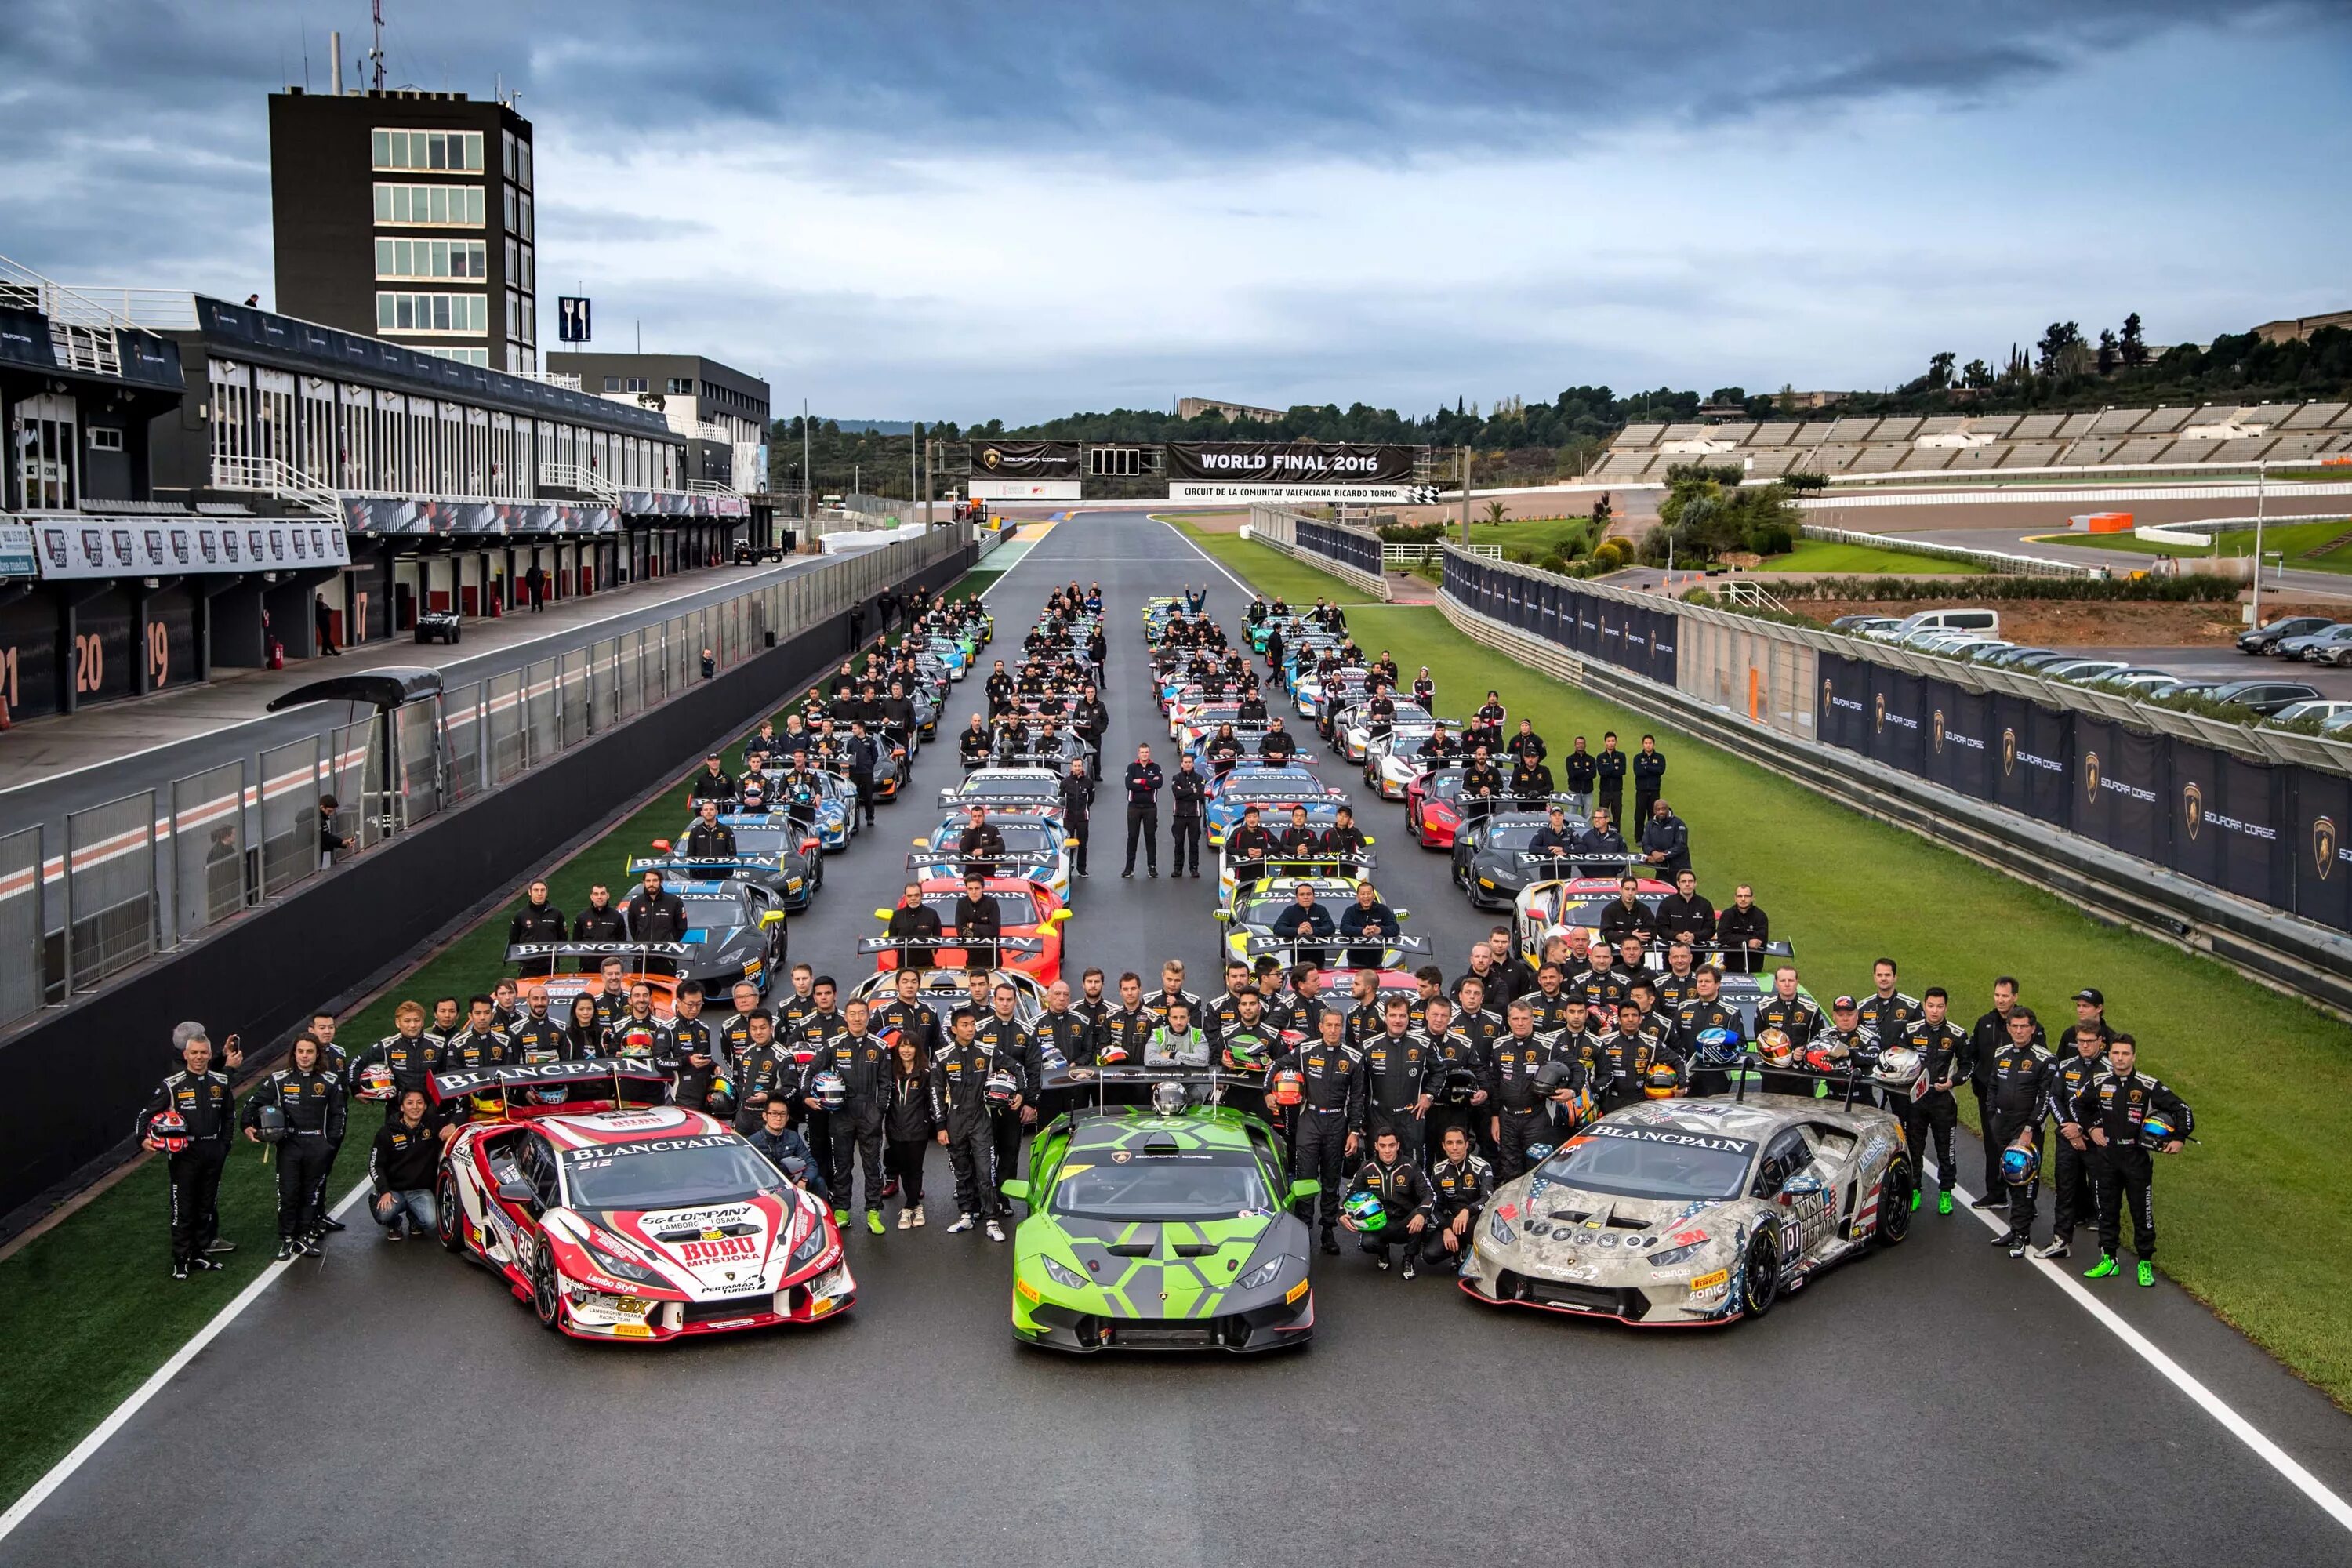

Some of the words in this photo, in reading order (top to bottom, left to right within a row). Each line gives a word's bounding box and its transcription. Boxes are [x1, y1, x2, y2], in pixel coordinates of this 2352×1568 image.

[1201, 454, 1266, 470] WORLD
[1272, 455, 1327, 470] FINAL
[1334, 456, 1378, 470] 2016
[1184, 488, 1214, 496] CIRCUIT
[1216, 488, 1225, 496] DE
[1229, 488, 1237, 496] LA
[1240, 488, 1283, 497] COMUNITAT
[1286, 488, 1331, 497] VALENCIANA
[1334, 489, 1367, 498] RICARDO
[357, 592, 367, 641] 17
[77, 633, 103, 692] 20
[147, 622, 168, 688] 19
[2042, 758, 2063, 771] CORSE
[943, 795, 1062, 804] BLANCPAIN
[1229, 793, 1346, 802] BLANCPAIN
[2132, 787, 2155, 802] CORSE
[2244, 822, 2276, 840] CORSE
[637, 857, 775, 867] BLANCPAIN
[913, 854, 1051, 864] BLANCPAIN
[517, 943, 691, 956] BLANCPAIN
[865, 937, 1035, 947] BLANCPAIN
[1255, 936, 1422, 948] BLANCPAIN
[436, 1058, 654, 1091] BLANCPAIN
[1590, 1126, 1748, 1153] BLANCPAIN
[572, 1135, 738, 1161] BLANCPAIN
[1560, 1144, 1581, 1155] 101
[578, 1160, 612, 1171] 212
[1795, 1190, 1824, 1221] WISH
[716, 1216, 742, 1225] OSAKA
[1673, 1229, 1708, 1247] 3M
[1781, 1225, 1799, 1255] 101
[519, 1234, 532, 1264] 212
[680, 1237, 756, 1261] BUBU
[686, 1254, 760, 1268] MITSUOKA
[587, 1273, 614, 1288] Lambo
[615, 1281, 639, 1294] Style
[1695, 1272, 1726, 1288] PIRELLI
[702, 1283, 754, 1294] PERTAMAX
[1690, 1284, 1724, 1301] sonic
[590, 1308, 623, 1317] LAMBORGHINI
